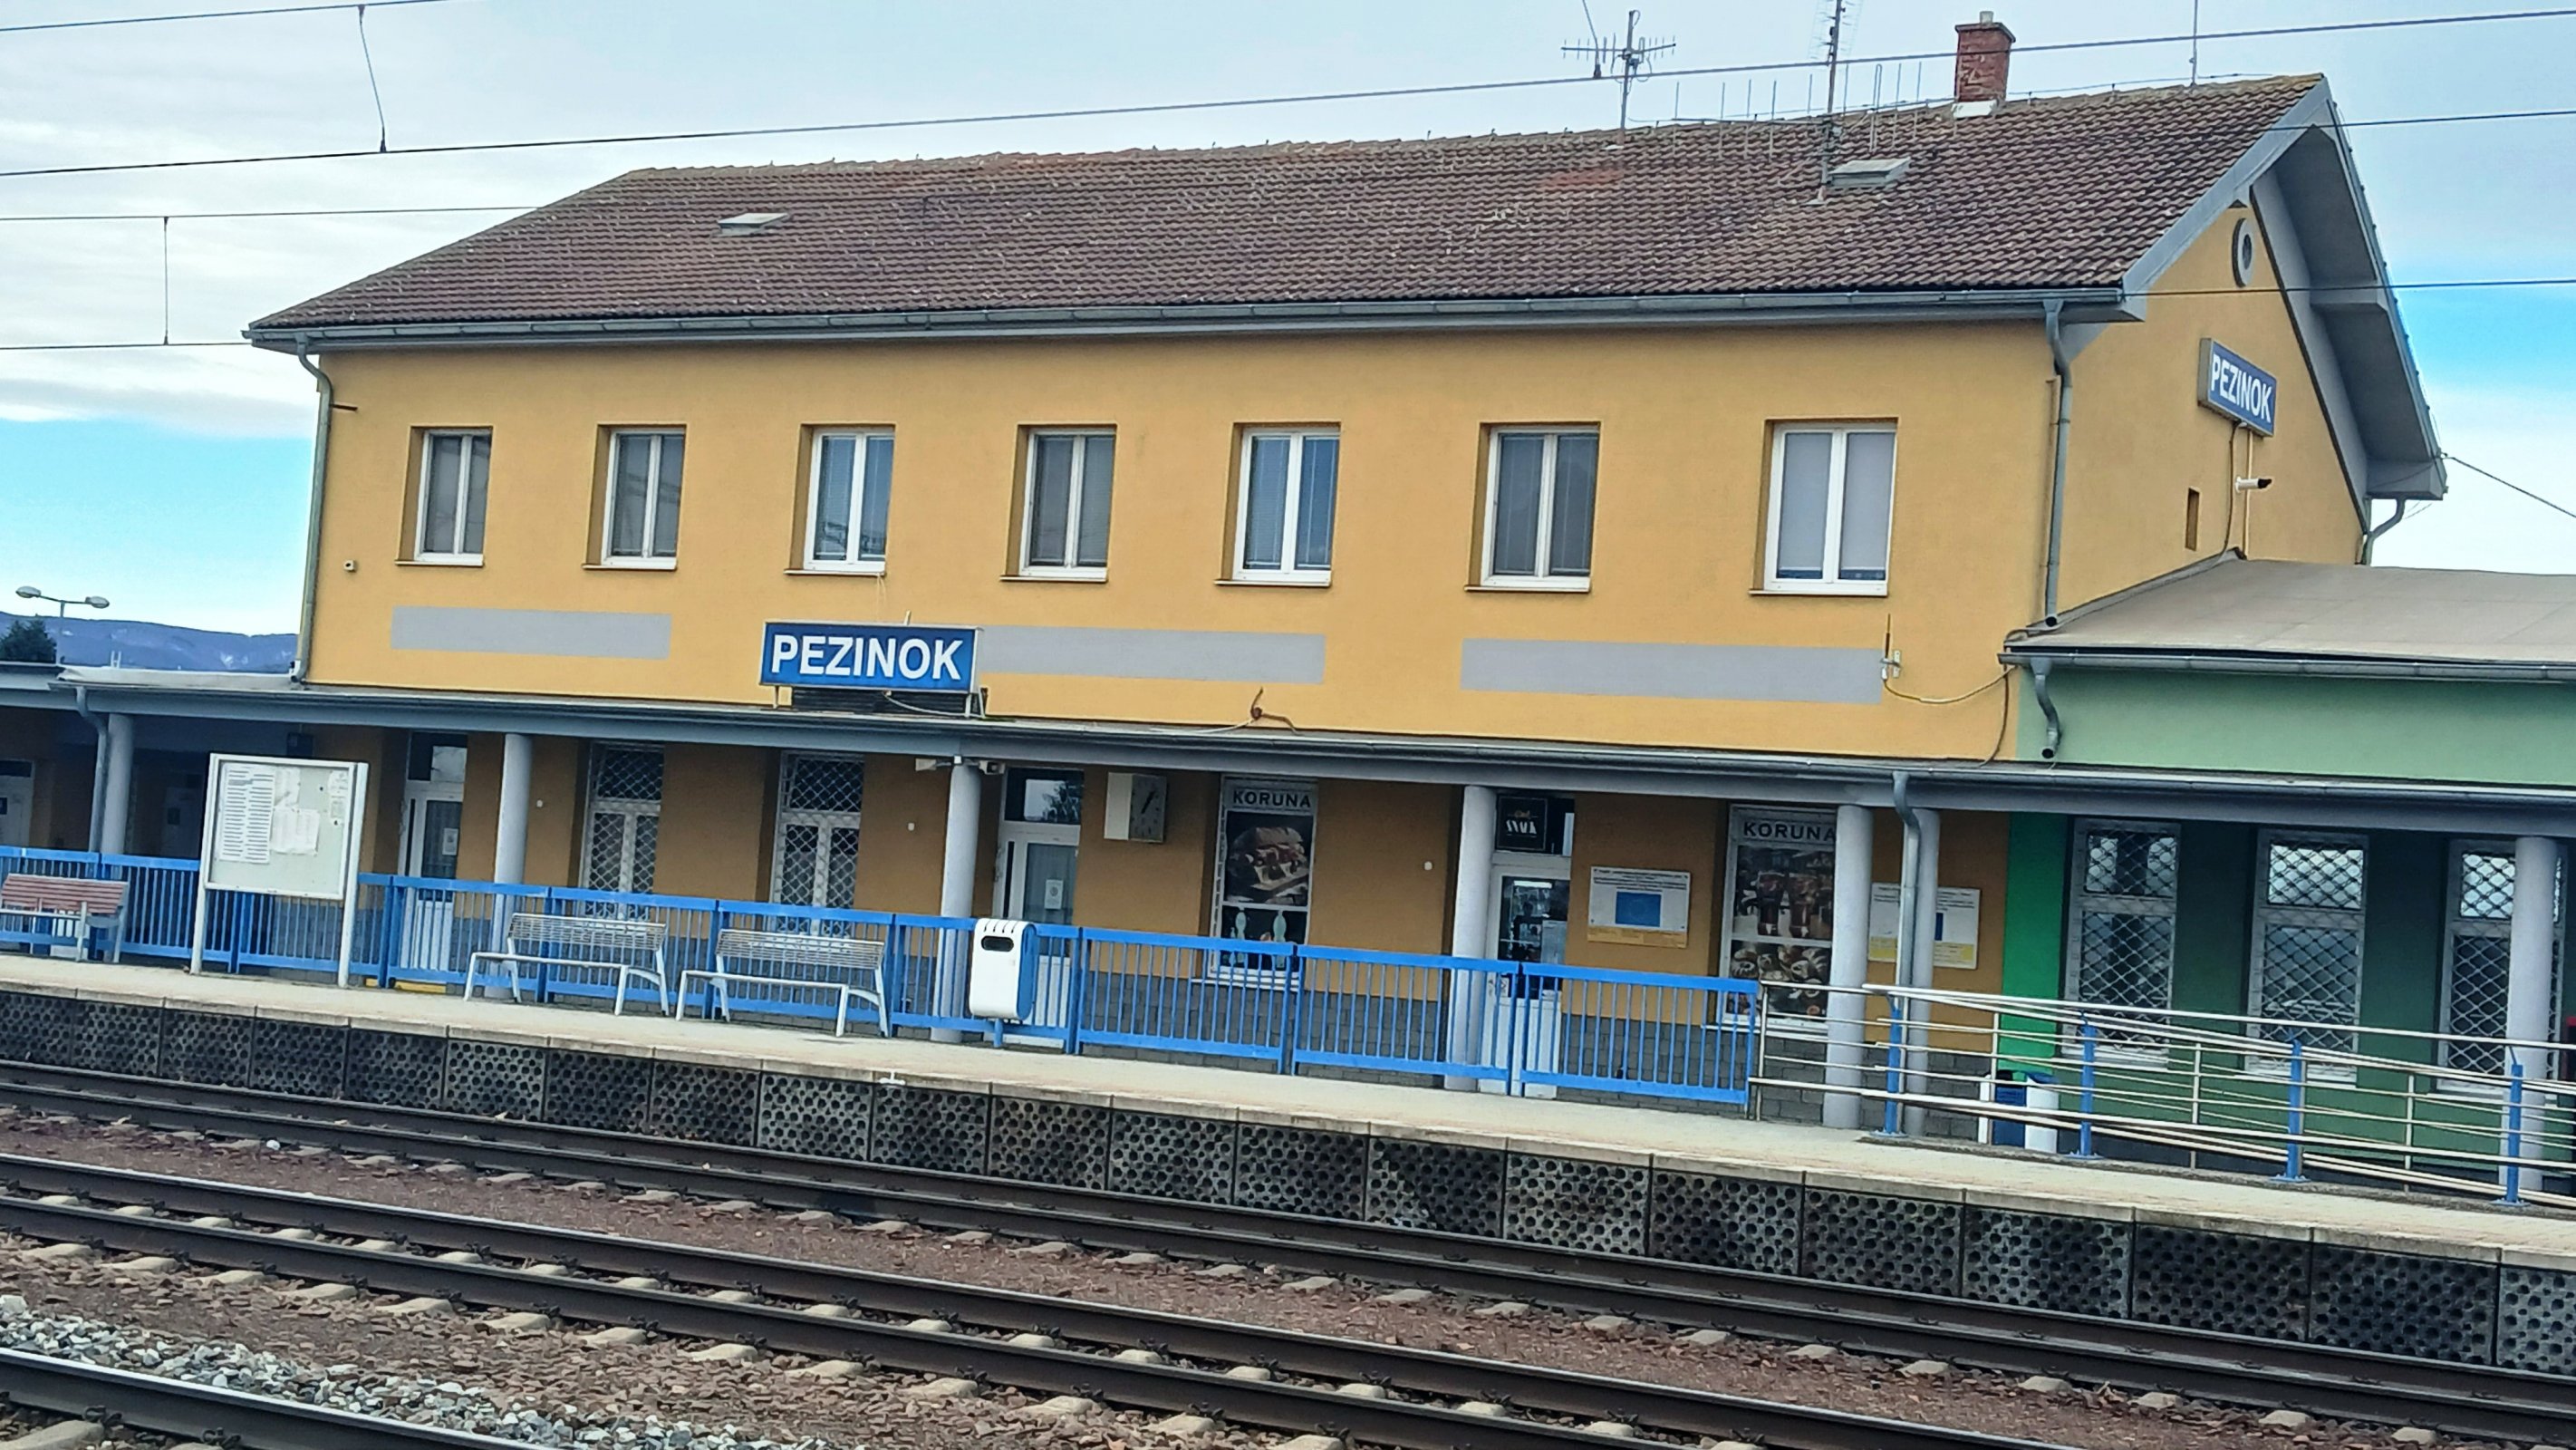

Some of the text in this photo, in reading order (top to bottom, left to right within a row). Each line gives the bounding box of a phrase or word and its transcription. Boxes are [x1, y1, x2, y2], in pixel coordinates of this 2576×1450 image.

[2211, 353, 2272, 423] PEZINOK
[771, 634, 963, 680] PEZINOK
[1233, 790, 1311, 808] KORUNA
[1743, 821, 1837, 842] KORUNA
